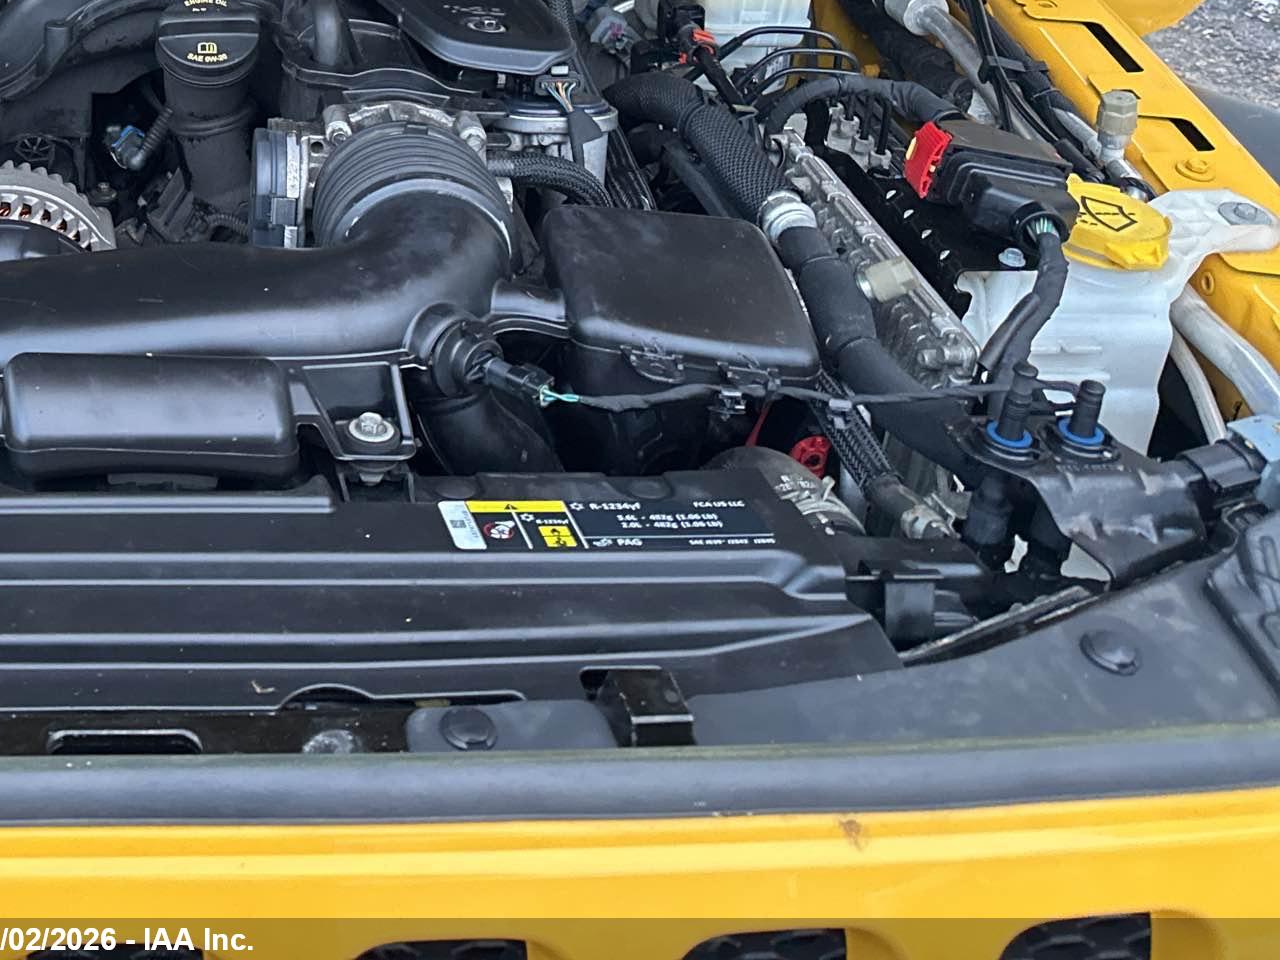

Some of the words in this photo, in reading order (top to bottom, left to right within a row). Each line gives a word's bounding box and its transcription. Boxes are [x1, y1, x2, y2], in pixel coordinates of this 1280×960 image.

[215, 0, 228, 7] OIL
[187, 53, 204, 62] SAE
[589, 502, 641, 511] R-1234yf
[617, 538, 642, 547] PAG
